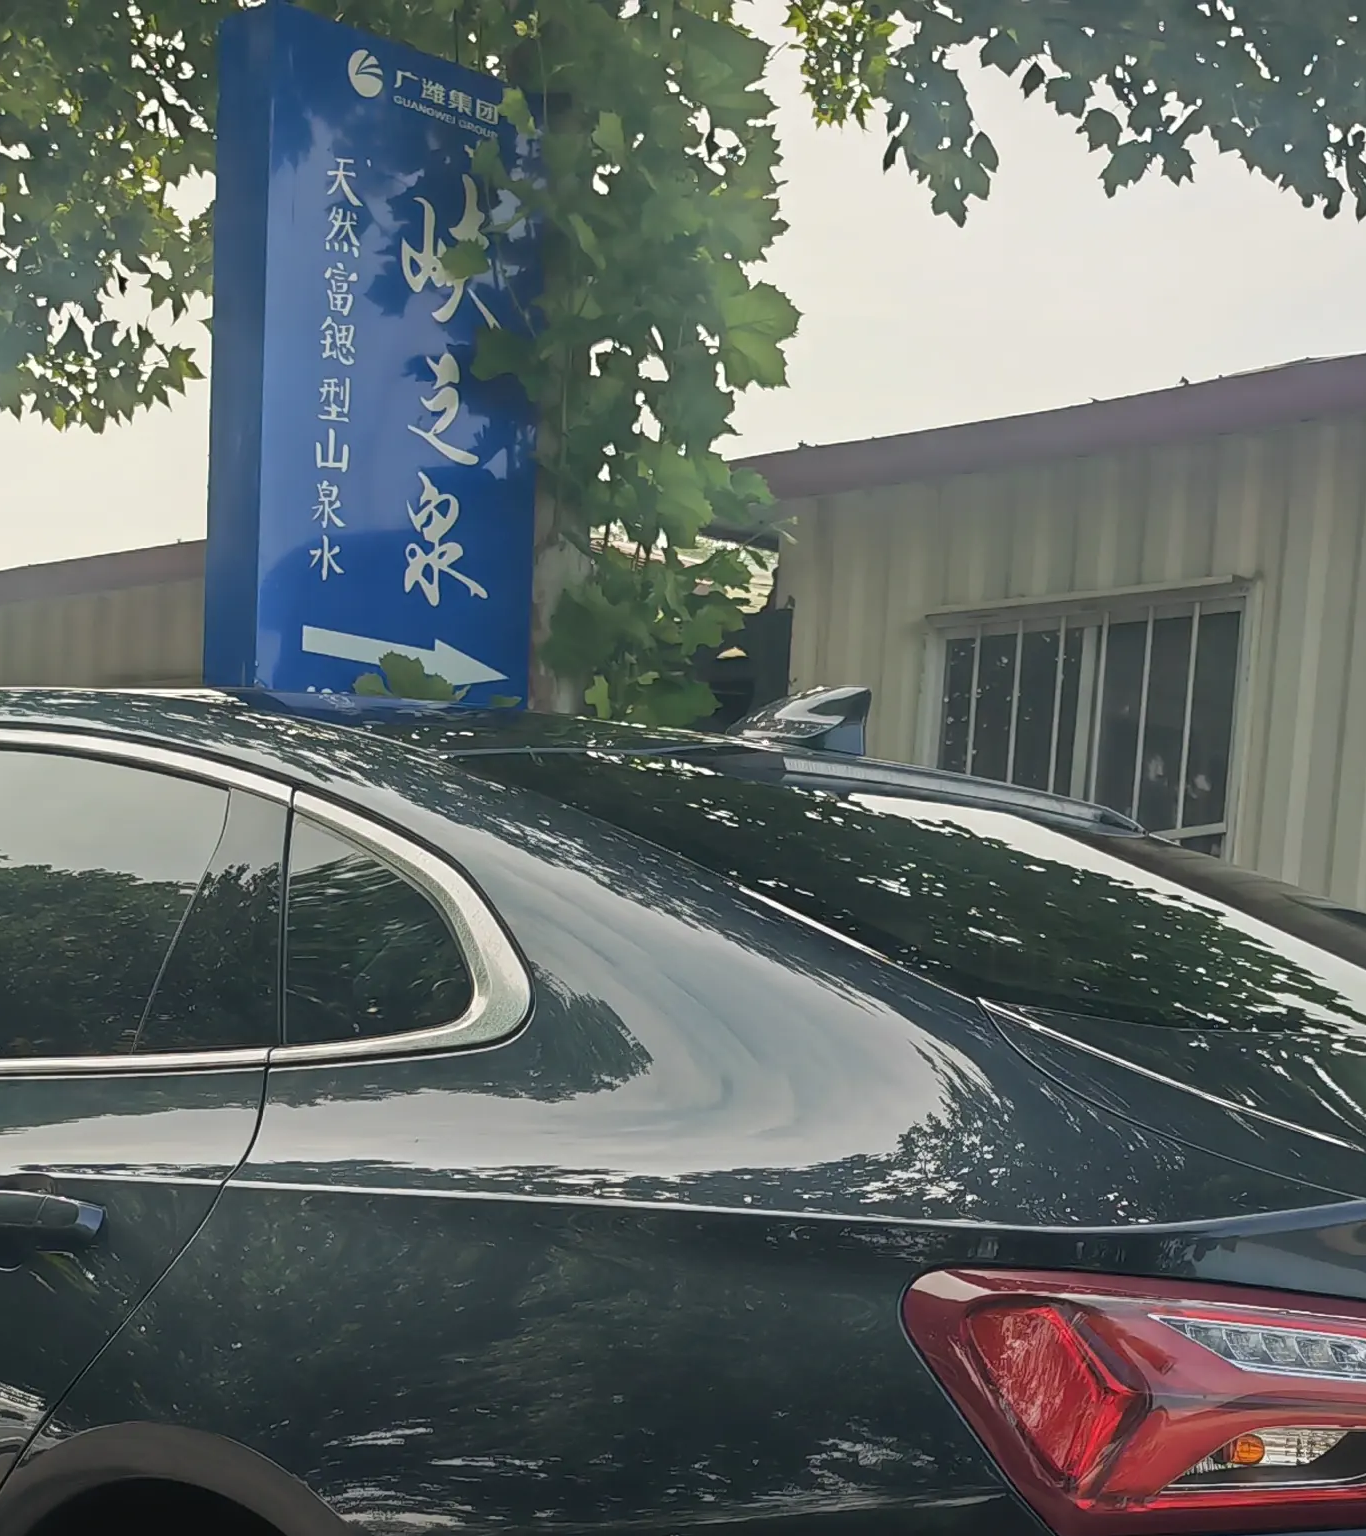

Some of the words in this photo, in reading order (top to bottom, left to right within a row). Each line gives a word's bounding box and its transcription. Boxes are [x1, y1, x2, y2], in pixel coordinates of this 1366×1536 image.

[392, 94, 457, 126] GUANGWEI
[393, 69, 499, 126] 广潍集团
[309, 157, 364, 582] 天然富锶型山泉水
